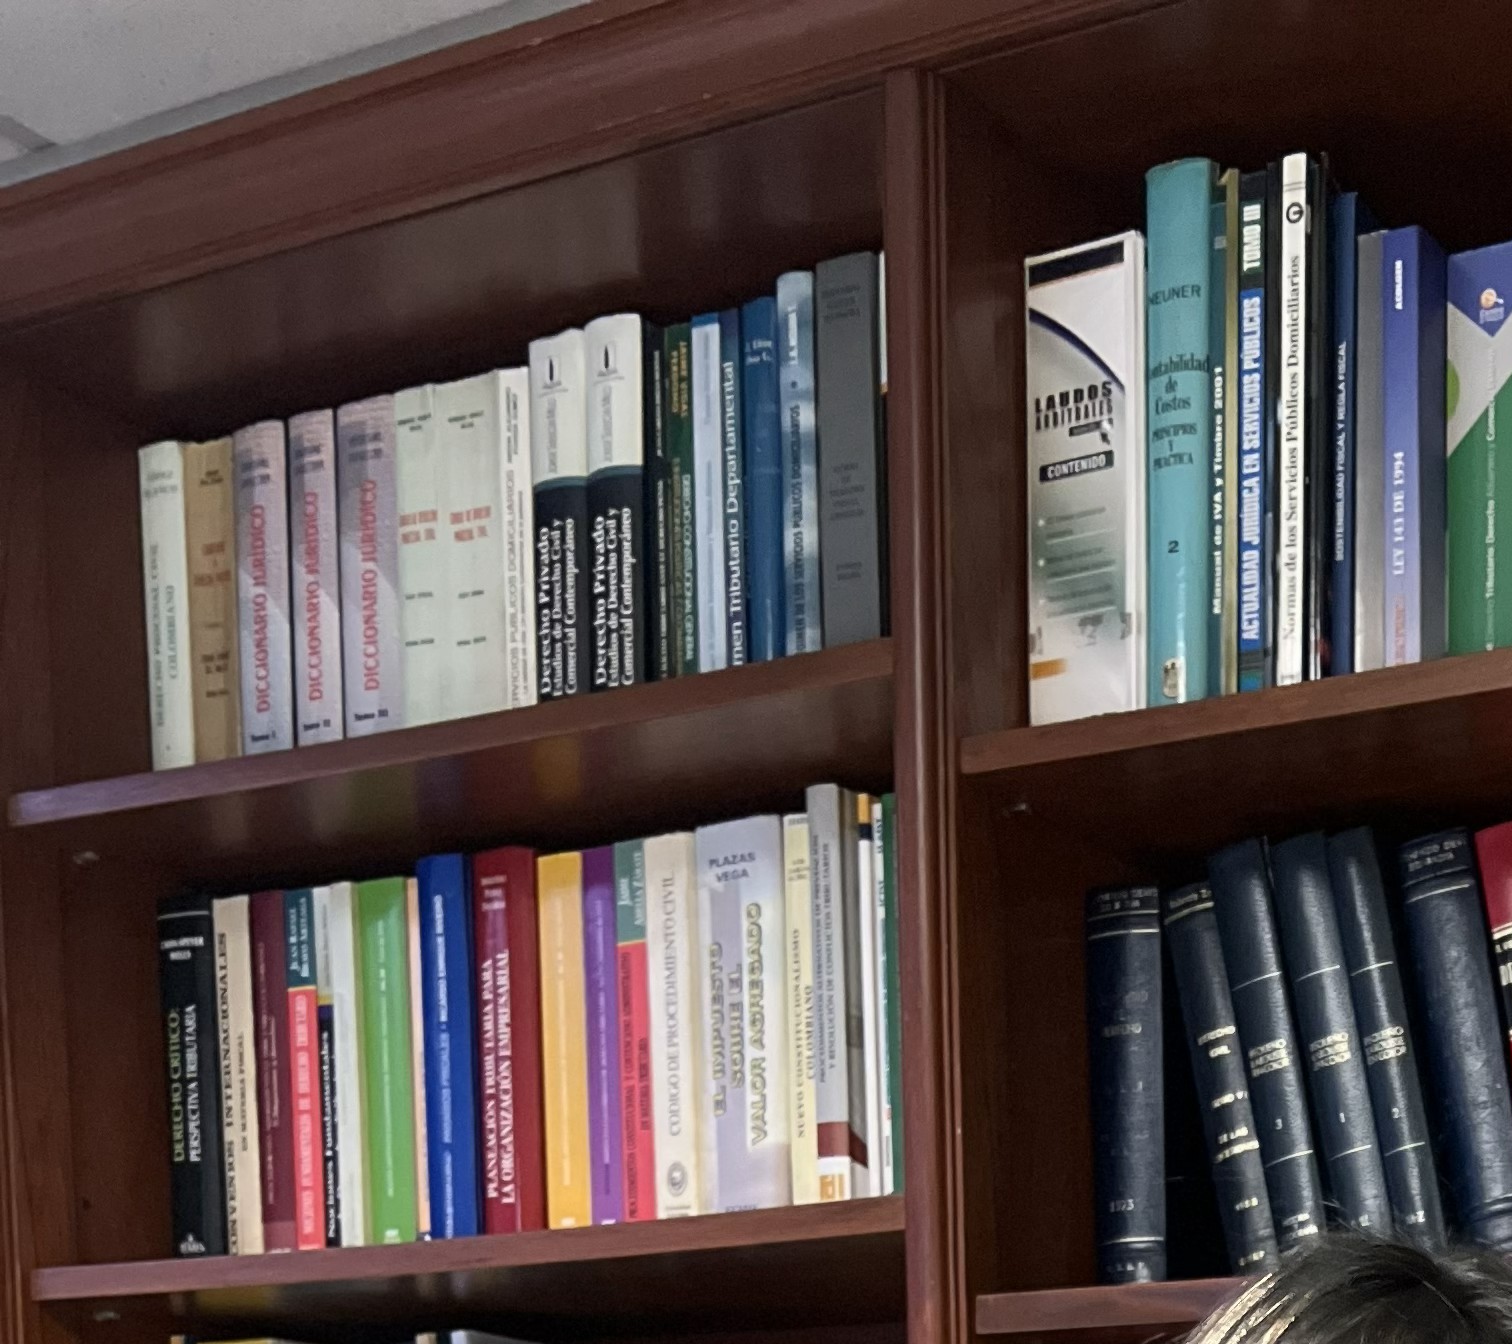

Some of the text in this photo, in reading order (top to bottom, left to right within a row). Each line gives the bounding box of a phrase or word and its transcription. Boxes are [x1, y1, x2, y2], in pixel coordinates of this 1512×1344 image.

[1243, 203, 1261, 271] TOMO III
[1241, 296, 1261, 370] PÚBLICOS
[1337, 340, 1347, 379] FISCAL
[1035, 381, 1112, 414] LAUDOS
[1035, 398, 1113, 433] ARBITRALES
[1155, 397, 1192, 415] Costos
[1242, 373, 1261, 450] SERVICIOS
[1336, 381, 1346, 420] REGLA
[1336, 422, 1346, 431] Y
[1047, 454, 1107, 479] CONTENIDO
[1242, 453, 1260, 474] EN
[1283, 255, 1300, 640] Normas de los Servicios Públicos Domiciliarios
[1336, 433, 1346, 471] FISCAL
[722, 361, 742, 618] Tributario Departamental
[1212, 367, 1223, 614] Manual de IVA y Timbre 2001
[1393, 451, 1405, 575] LEY 143 DE 1994
[551, 530, 562, 561] Civil
[606, 520, 617, 549] Civil
[1167, 540, 1179, 554] 2
[539, 527, 552, 694] Derecho Privado
[551, 563, 563, 619] Derecho
[593, 516, 607, 685] Derecho Privado
[607, 553, 618, 608] Derecho
[1241, 550, 1259, 640] ACTUALIDAD
[253, 593, 271, 713] DICCIONARIO
[302, 580, 323, 702] DICCIONARIO
[360, 570, 380, 691] DICCIONARIO
[552, 622, 563, 640] de
[608, 612, 618, 630] de
[621, 618, 634, 685] Comercial
[565, 627, 578, 694] Comercial
[708, 852, 756, 869] PLAZAS
[715, 867, 750, 883] VEGA
[663, 871, 683, 1136] CODIGO DE PROCEDIMIENTO CIVIL
[710, 942, 726, 1117] EL IMPUESTO
[730, 964, 745, 1089] SOBRE EL
[747, 902, 767, 1146] VALOR AGREGADO
[792, 928, 806, 1139] NUEVO CONSTITUCIONALISMO
[804, 984, 816, 1081] COLOMBIANO
[185, 1004, 202, 1163] PERSPECTIVA TRIBUTARIA
[481, 958, 498, 1199] PLANEACIÓN TRIBUTARIA PARA
[496, 948, 515, 1205] LA ORGANIZACIÓN EMPRESARIAL
